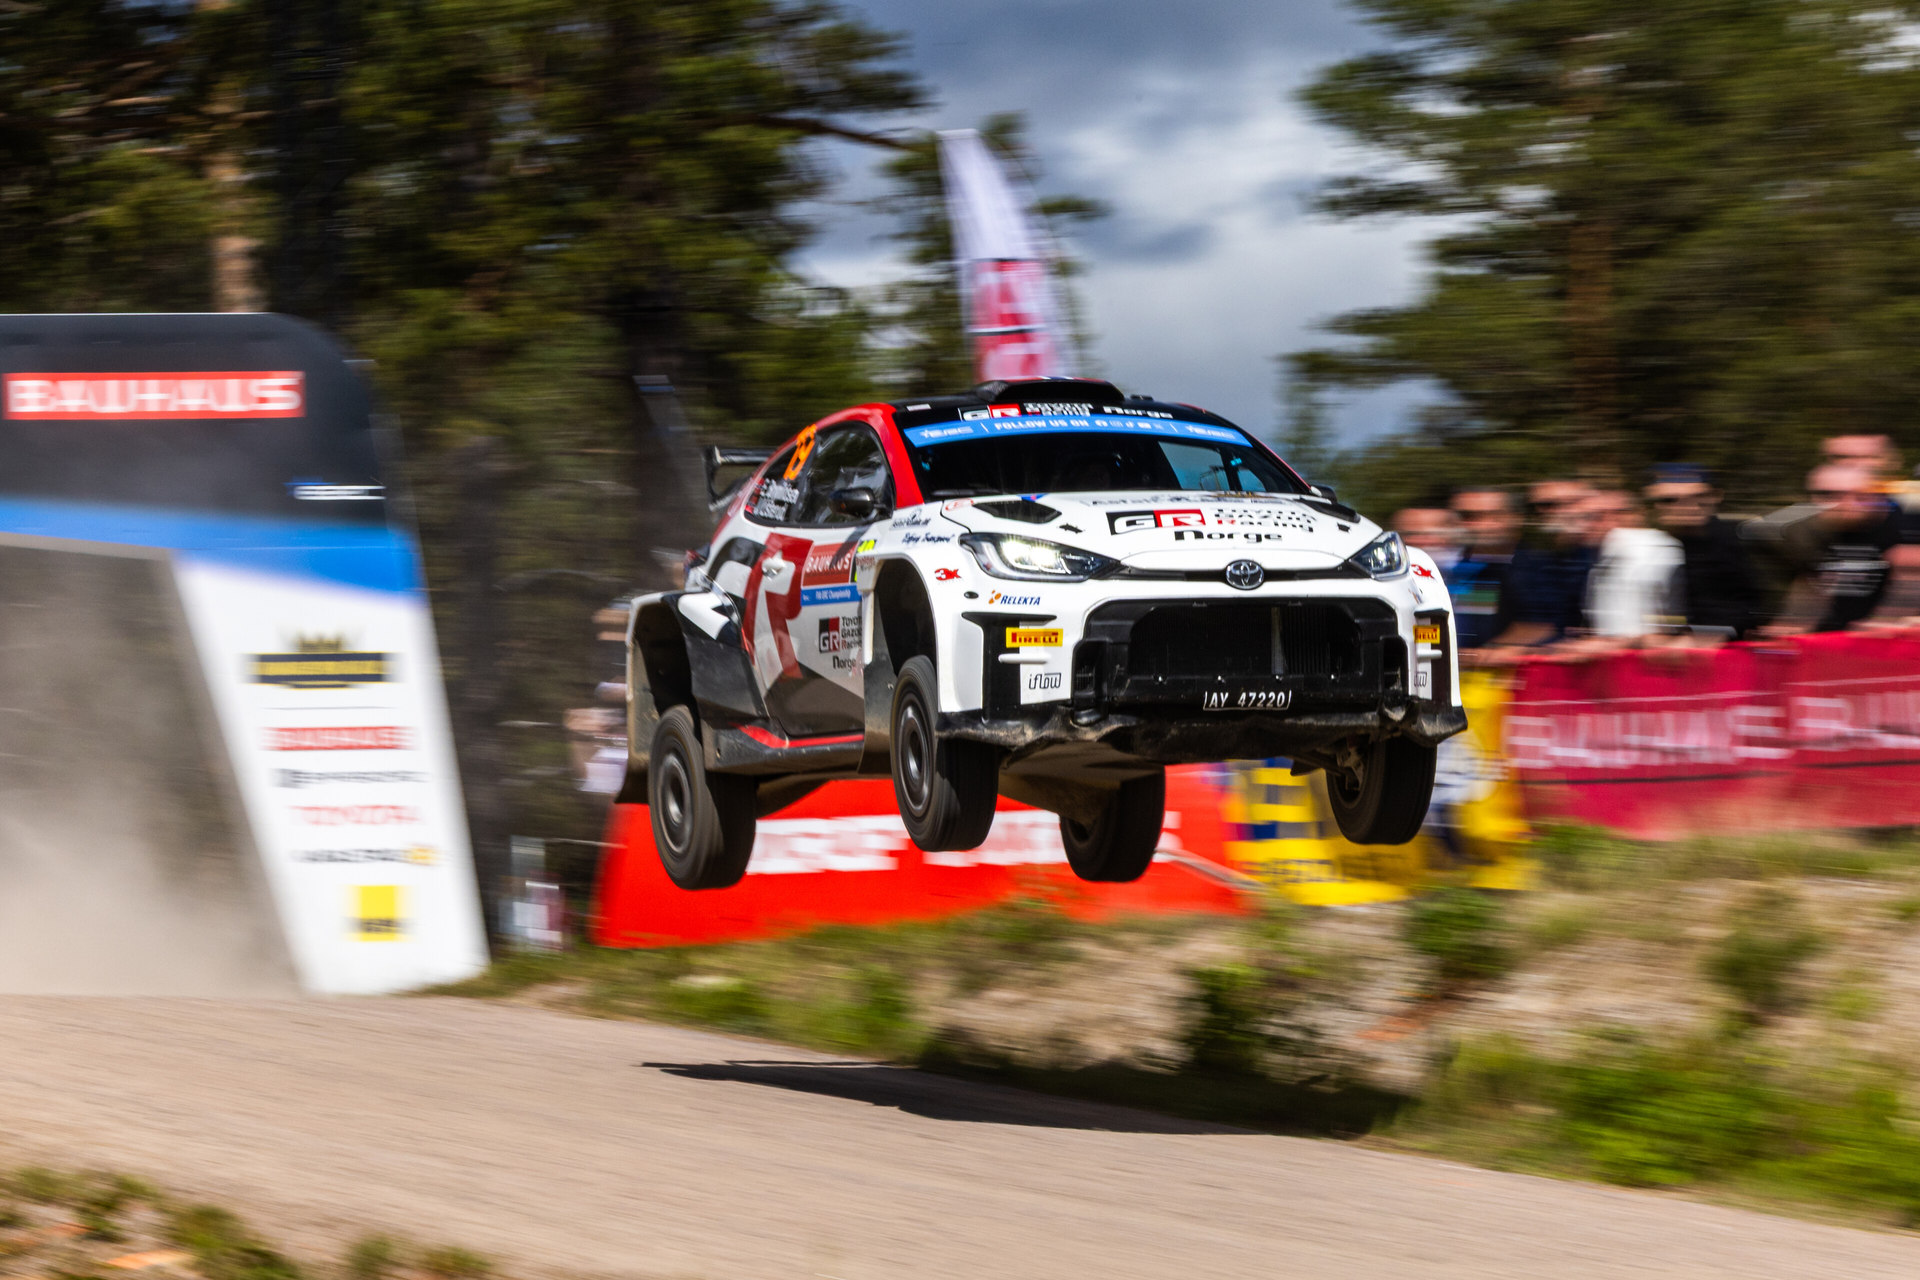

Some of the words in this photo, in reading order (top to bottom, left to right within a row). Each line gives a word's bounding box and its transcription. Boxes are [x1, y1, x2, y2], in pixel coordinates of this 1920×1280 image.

[994, 420, 1046, 431] FOLLOW
[1049, 419, 1068, 428] US
[1070, 419, 1089, 427] ON
[1110, 511, 1204, 534] GR
[1175, 530, 1282, 544] Norge
[1000, 595, 1041, 606] RELEKTA
[841, 616, 862, 627] TOYOT
[820, 632, 839, 650] GR
[1011, 631, 1059, 643] PIRELLI
[832, 655, 857, 671] Norge
[1028, 672, 1062, 690] iflow
[1208, 692, 1229, 708] AY
[1237, 691, 1286, 708] 47220
